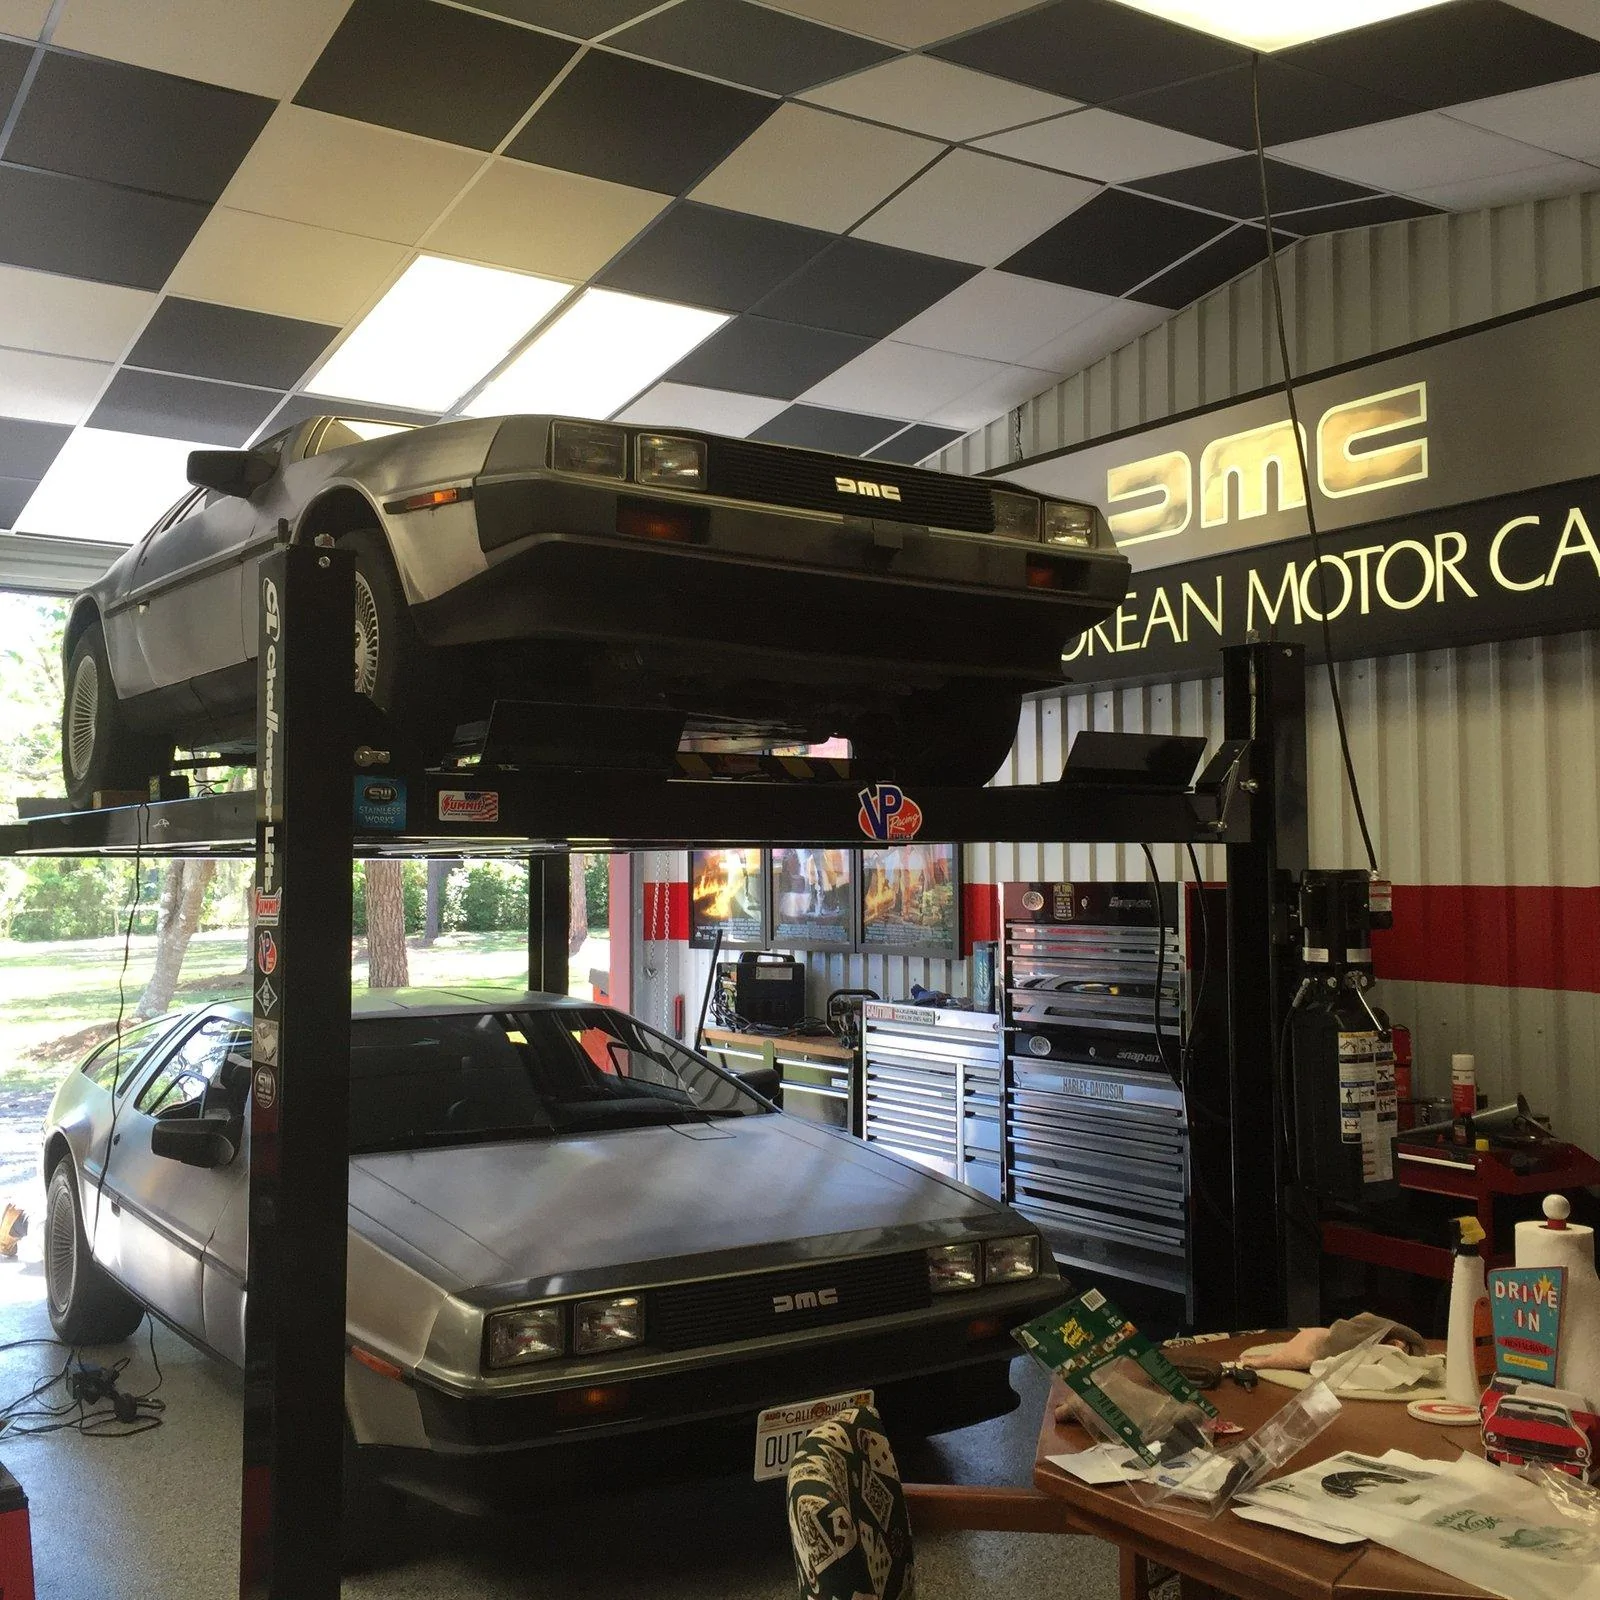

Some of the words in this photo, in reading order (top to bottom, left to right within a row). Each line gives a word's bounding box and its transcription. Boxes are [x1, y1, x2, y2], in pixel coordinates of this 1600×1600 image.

[1246, 531, 1478, 632] MOTOR
[1488, 507, 1600, 592] CA
[263, 645, 278, 823] Challenger
[1062, 1077, 1124, 1100] HARLEY-DAVIDSON
[1495, 1280, 1558, 1309] DRIVE
[1517, 1309, 1540, 1332] IN
[765, 1430, 812, 1468] OUT
